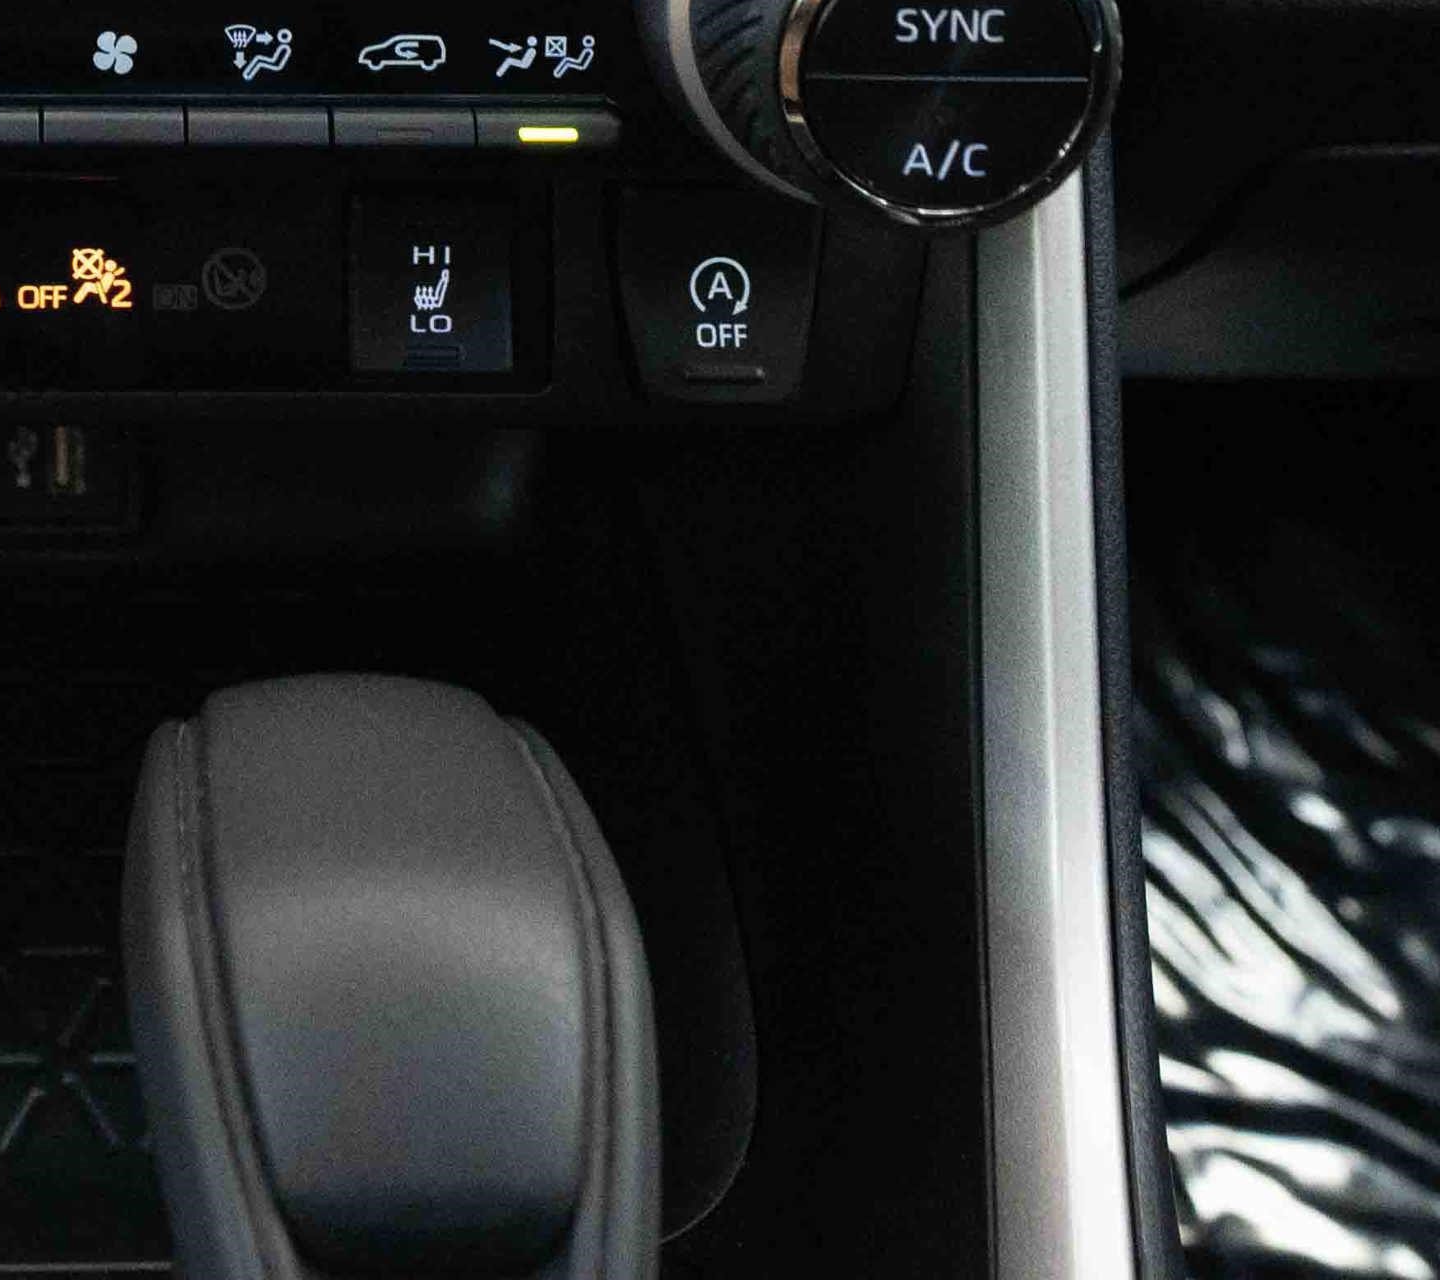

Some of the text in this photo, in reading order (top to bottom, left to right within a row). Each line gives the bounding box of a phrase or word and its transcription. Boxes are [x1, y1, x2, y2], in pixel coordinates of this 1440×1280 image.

[895, 8, 1005, 43] SYNC
[903, 140, 987, 181] A/C
[412, 245, 451, 265] HI
[17, 285, 68, 310] OFF
[410, 314, 453, 334] LO
[696, 323, 748, 348] OFF
